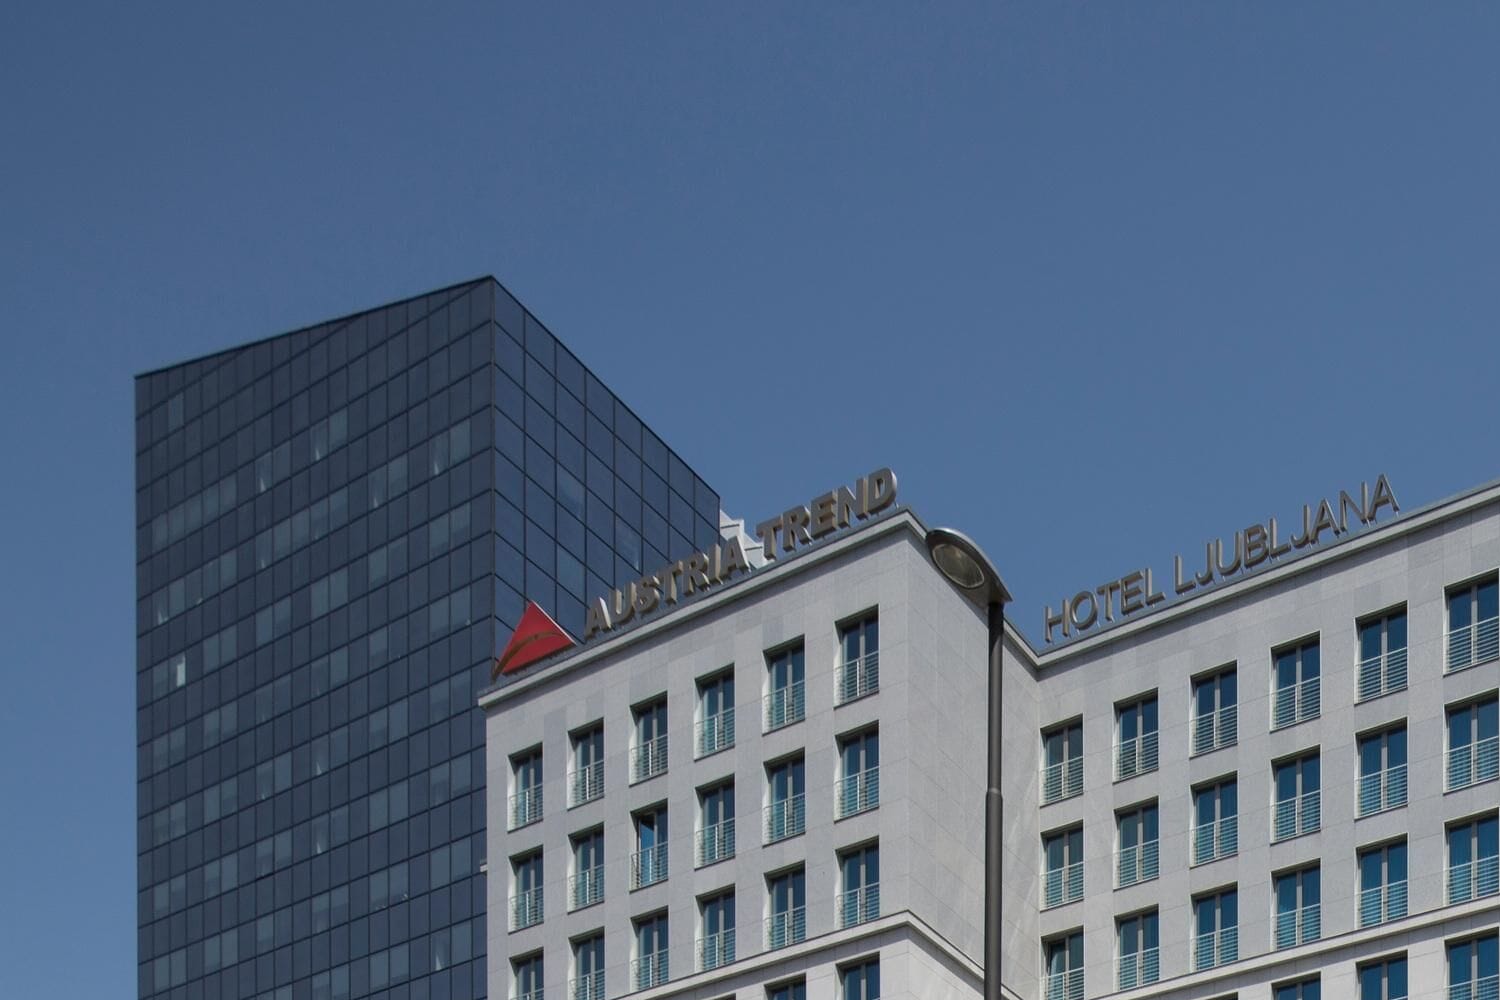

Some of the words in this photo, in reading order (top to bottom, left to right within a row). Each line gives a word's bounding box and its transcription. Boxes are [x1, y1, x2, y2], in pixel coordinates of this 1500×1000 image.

[584, 534, 750, 639] AUSTRIA
[756, 466, 899, 560] TREND
[1044, 567, 1165, 643] HOTEL
[1175, 473, 1400, 595] LJUBLJANA
